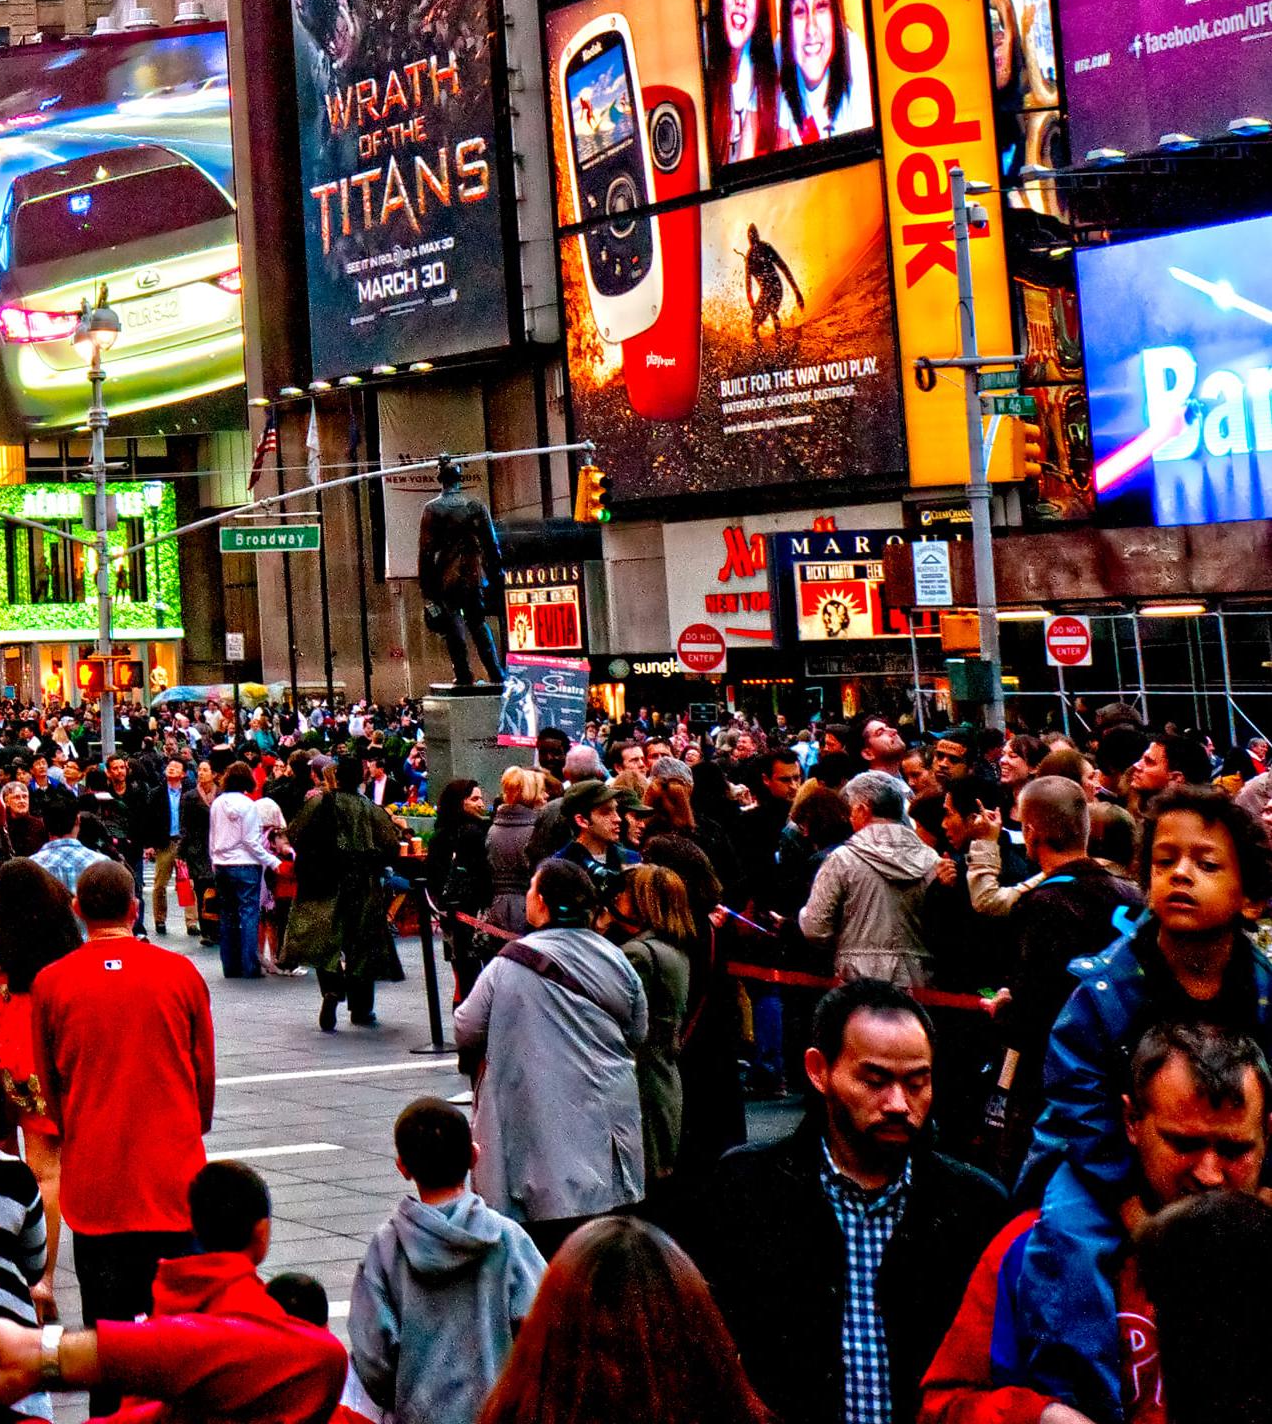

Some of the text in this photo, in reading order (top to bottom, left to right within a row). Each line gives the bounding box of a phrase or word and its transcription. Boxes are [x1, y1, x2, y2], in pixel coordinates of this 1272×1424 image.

[324, 50, 462, 134] WRATH
[390, 116, 428, 149] THE
[309, 137, 489, 256] TITANS
[357, 261, 446, 304] MARCH 30
[720, 356, 879, 397] BUILT FOR THE WAY YOU PLAY.
[1008, 399, 1022, 414] 46
[412, 475, 435, 483] YORK
[235, 532, 305, 547] Broadway
[504, 566, 579, 585] MARQUIS
[806, 565, 855, 580] RICKY MARTIN
[705, 594, 739, 613] NEW
[684, 632, 716, 642] DO NOT
[1052, 625, 1081, 635] DO NOT
[687, 653, 716, 663] ENTER
[1055, 646, 1082, 656] ENTER
